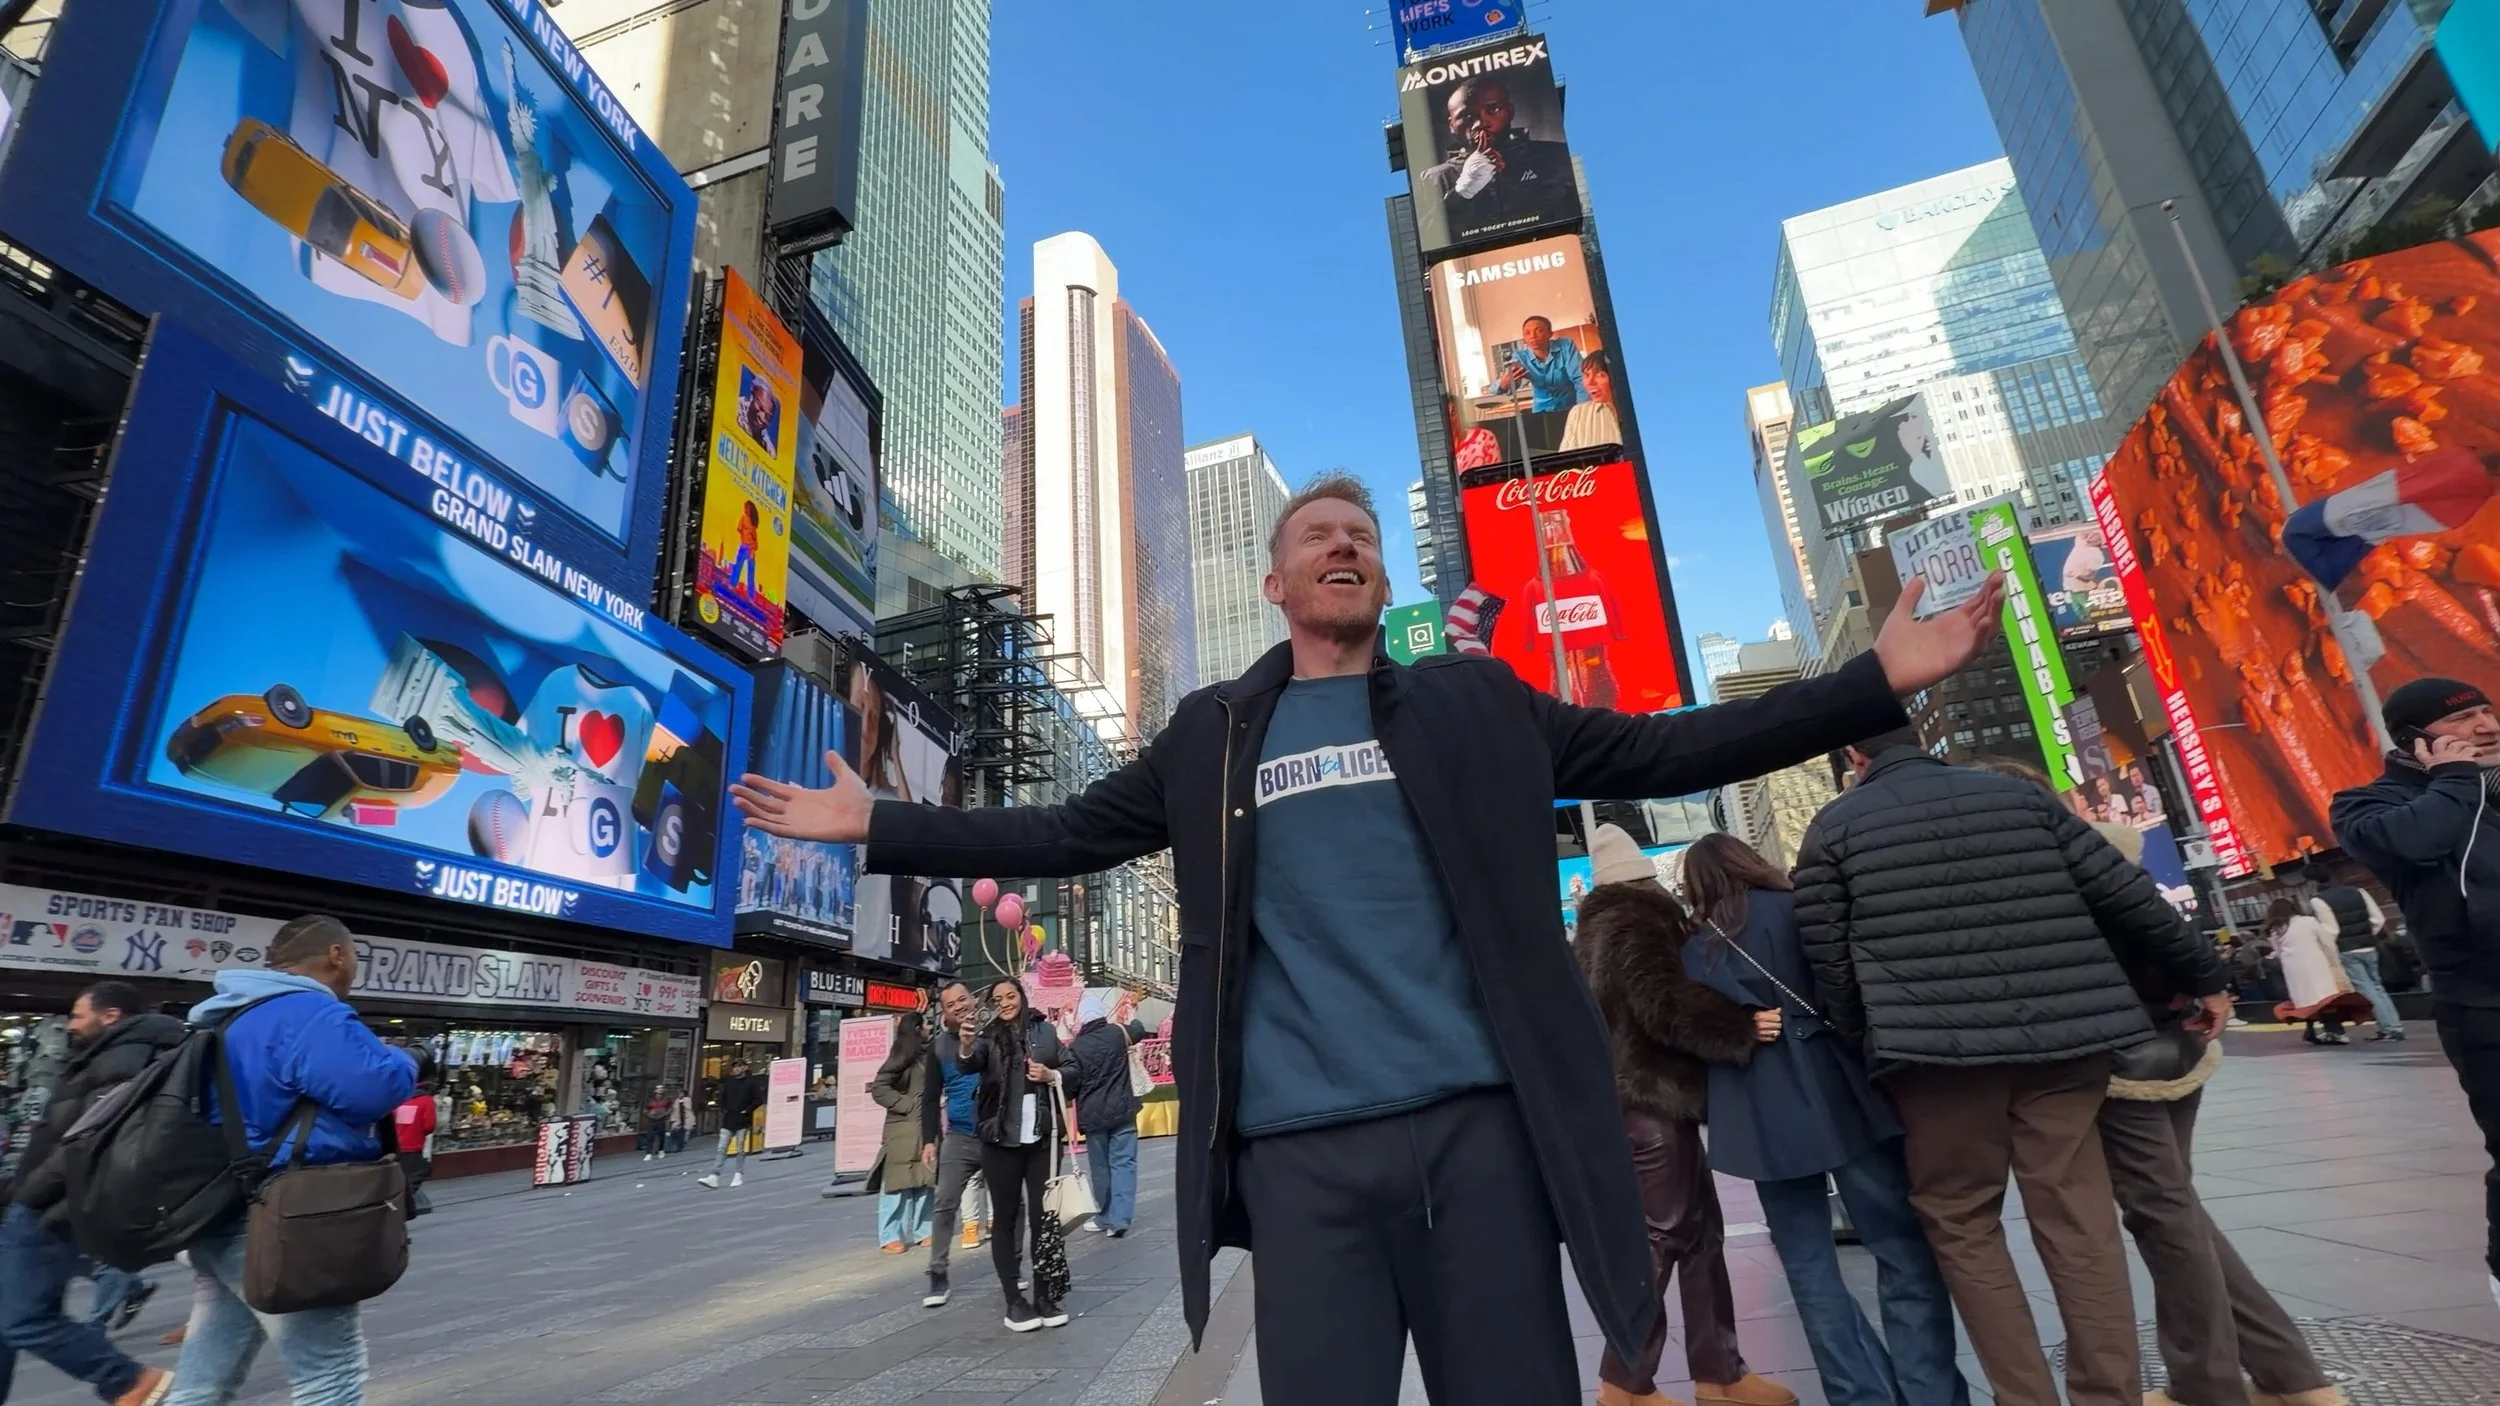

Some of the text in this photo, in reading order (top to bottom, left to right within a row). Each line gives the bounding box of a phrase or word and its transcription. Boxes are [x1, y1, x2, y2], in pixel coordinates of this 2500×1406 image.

[1400, 0, 1450, 23] LIFE'S
[1402, 13, 1455, 35] WORK
[533, 10, 585, 83] NEW
[586, 73, 638, 151] YORK
[1400, 41, 1548, 93] MONTIREX
[320, 49, 453, 198] NY
[1451, 250, 1566, 289] SAMSUNG
[317, 385, 513, 523] JUST BELOW
[718, 431, 748, 477] HELL'S
[750, 461, 787, 512] KITCHEN
[1862, 462, 1899, 480] Heart.
[1496, 465, 1599, 511] Coca-Cola
[1905, 513, 1965, 558] LITTLE
[431, 488, 507, 551] GRAND
[509, 534, 562, 584] SLAM
[563, 566, 603, 607] NEW
[604, 589, 645, 632] YORK
[1996, 545, 2072, 747] CANNABIS
[2166, 690, 2225, 814] HERSHEY'S
[1260, 754, 1323, 798] BORN
[1319, 754, 1341, 776] to
[432, 866, 564, 916] JUST BELOW
[47, 894, 237, 935] SPORTS FAN SHOP
[351, 939, 563, 1002] GRAND SLAM
[581, 966, 628, 981] DISCOUNT
[584, 980, 610, 991] GIFTS
[810, 970, 865, 994] BLUE FIN
[574, 991, 627, 1006] SOUVENIRS
[729, 1016, 770, 1032] HEYTEA
[845, 1045, 887, 1057] MAGIC
